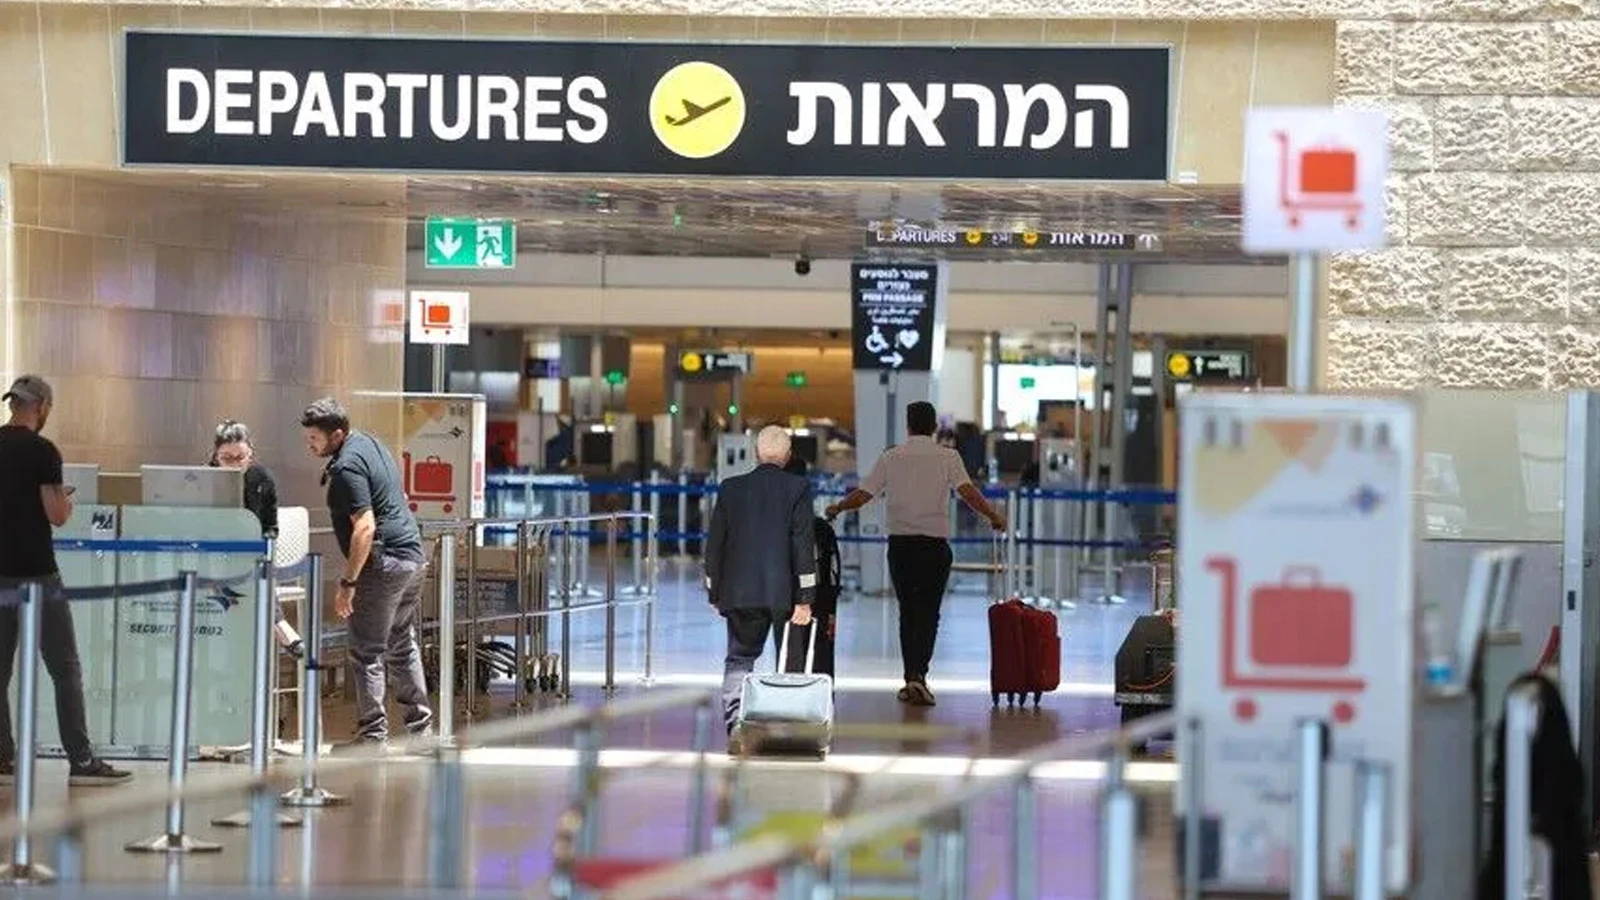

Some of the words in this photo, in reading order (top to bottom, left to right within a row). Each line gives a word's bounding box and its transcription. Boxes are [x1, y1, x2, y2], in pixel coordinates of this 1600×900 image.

[165, 67, 609, 145] DEPARTURES
[786, 80, 1131, 151] המראות
[876, 229, 957, 243] PARTURES
[1050, 231, 1124, 245] המראות
[883, 292, 924, 303] PASSAGE
[129, 623, 177, 634] SECURIT
